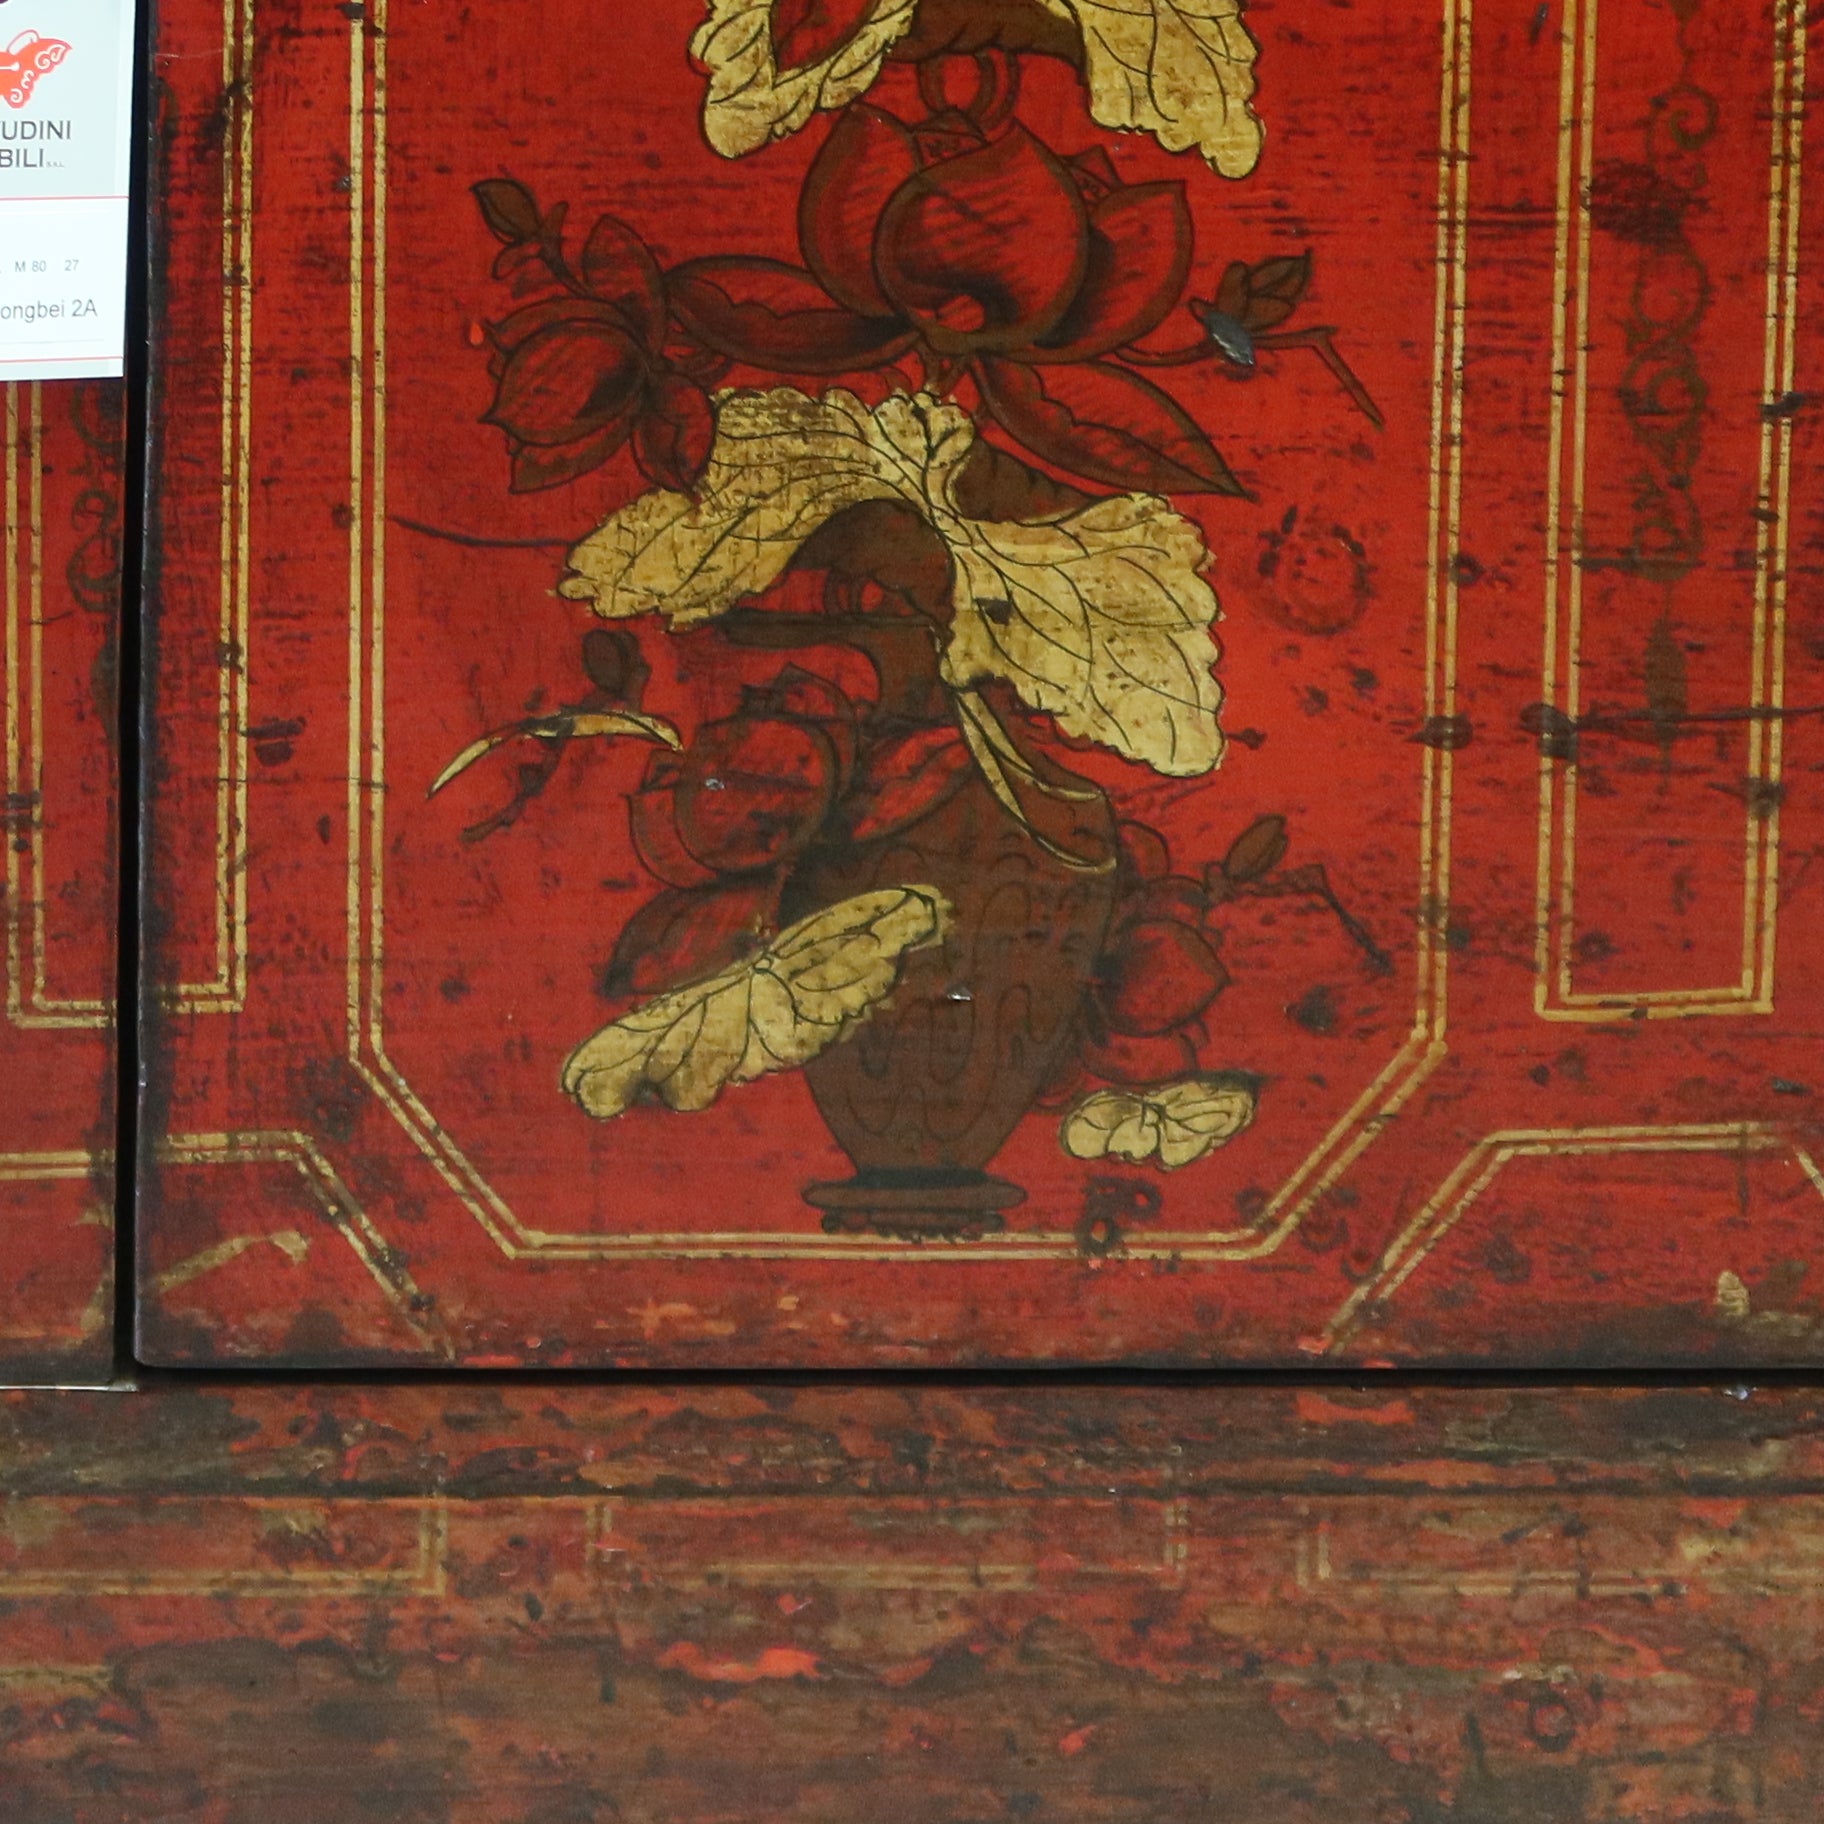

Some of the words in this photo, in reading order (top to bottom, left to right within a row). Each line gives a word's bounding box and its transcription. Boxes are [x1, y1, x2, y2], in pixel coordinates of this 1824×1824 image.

[14, 260, 26, 273] M
[31, 260, 47, 272] 80
[63, 259, 80, 272] 27
[71, 298, 98, 318] 2A
